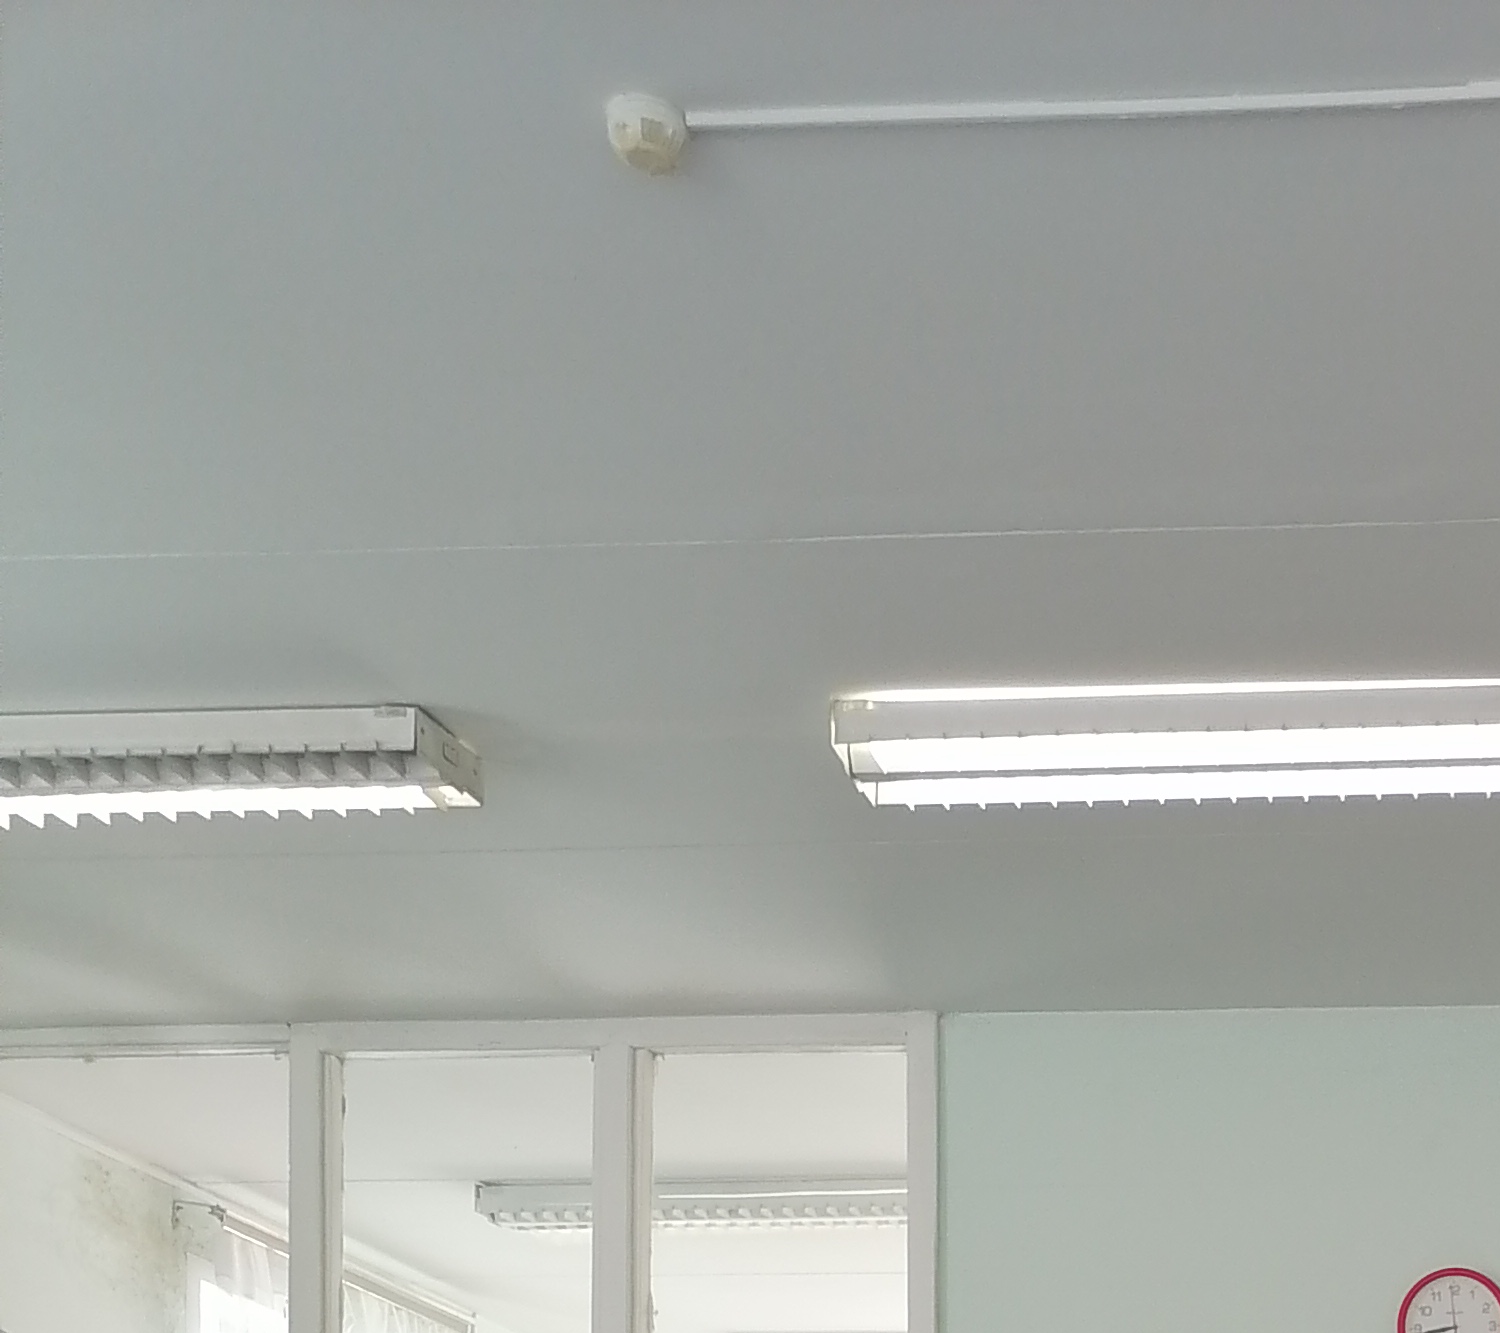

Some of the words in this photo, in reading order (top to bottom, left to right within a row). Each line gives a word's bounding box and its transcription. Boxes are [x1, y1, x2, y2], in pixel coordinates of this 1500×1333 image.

[1431, 1291, 1443, 1302] 11
[1469, 1289, 1476, 1300] 1
[1419, 1305, 1433, 1317] 10
[1481, 1302, 1491, 1314] 2
[1488, 1320, 1498, 1332] 3
